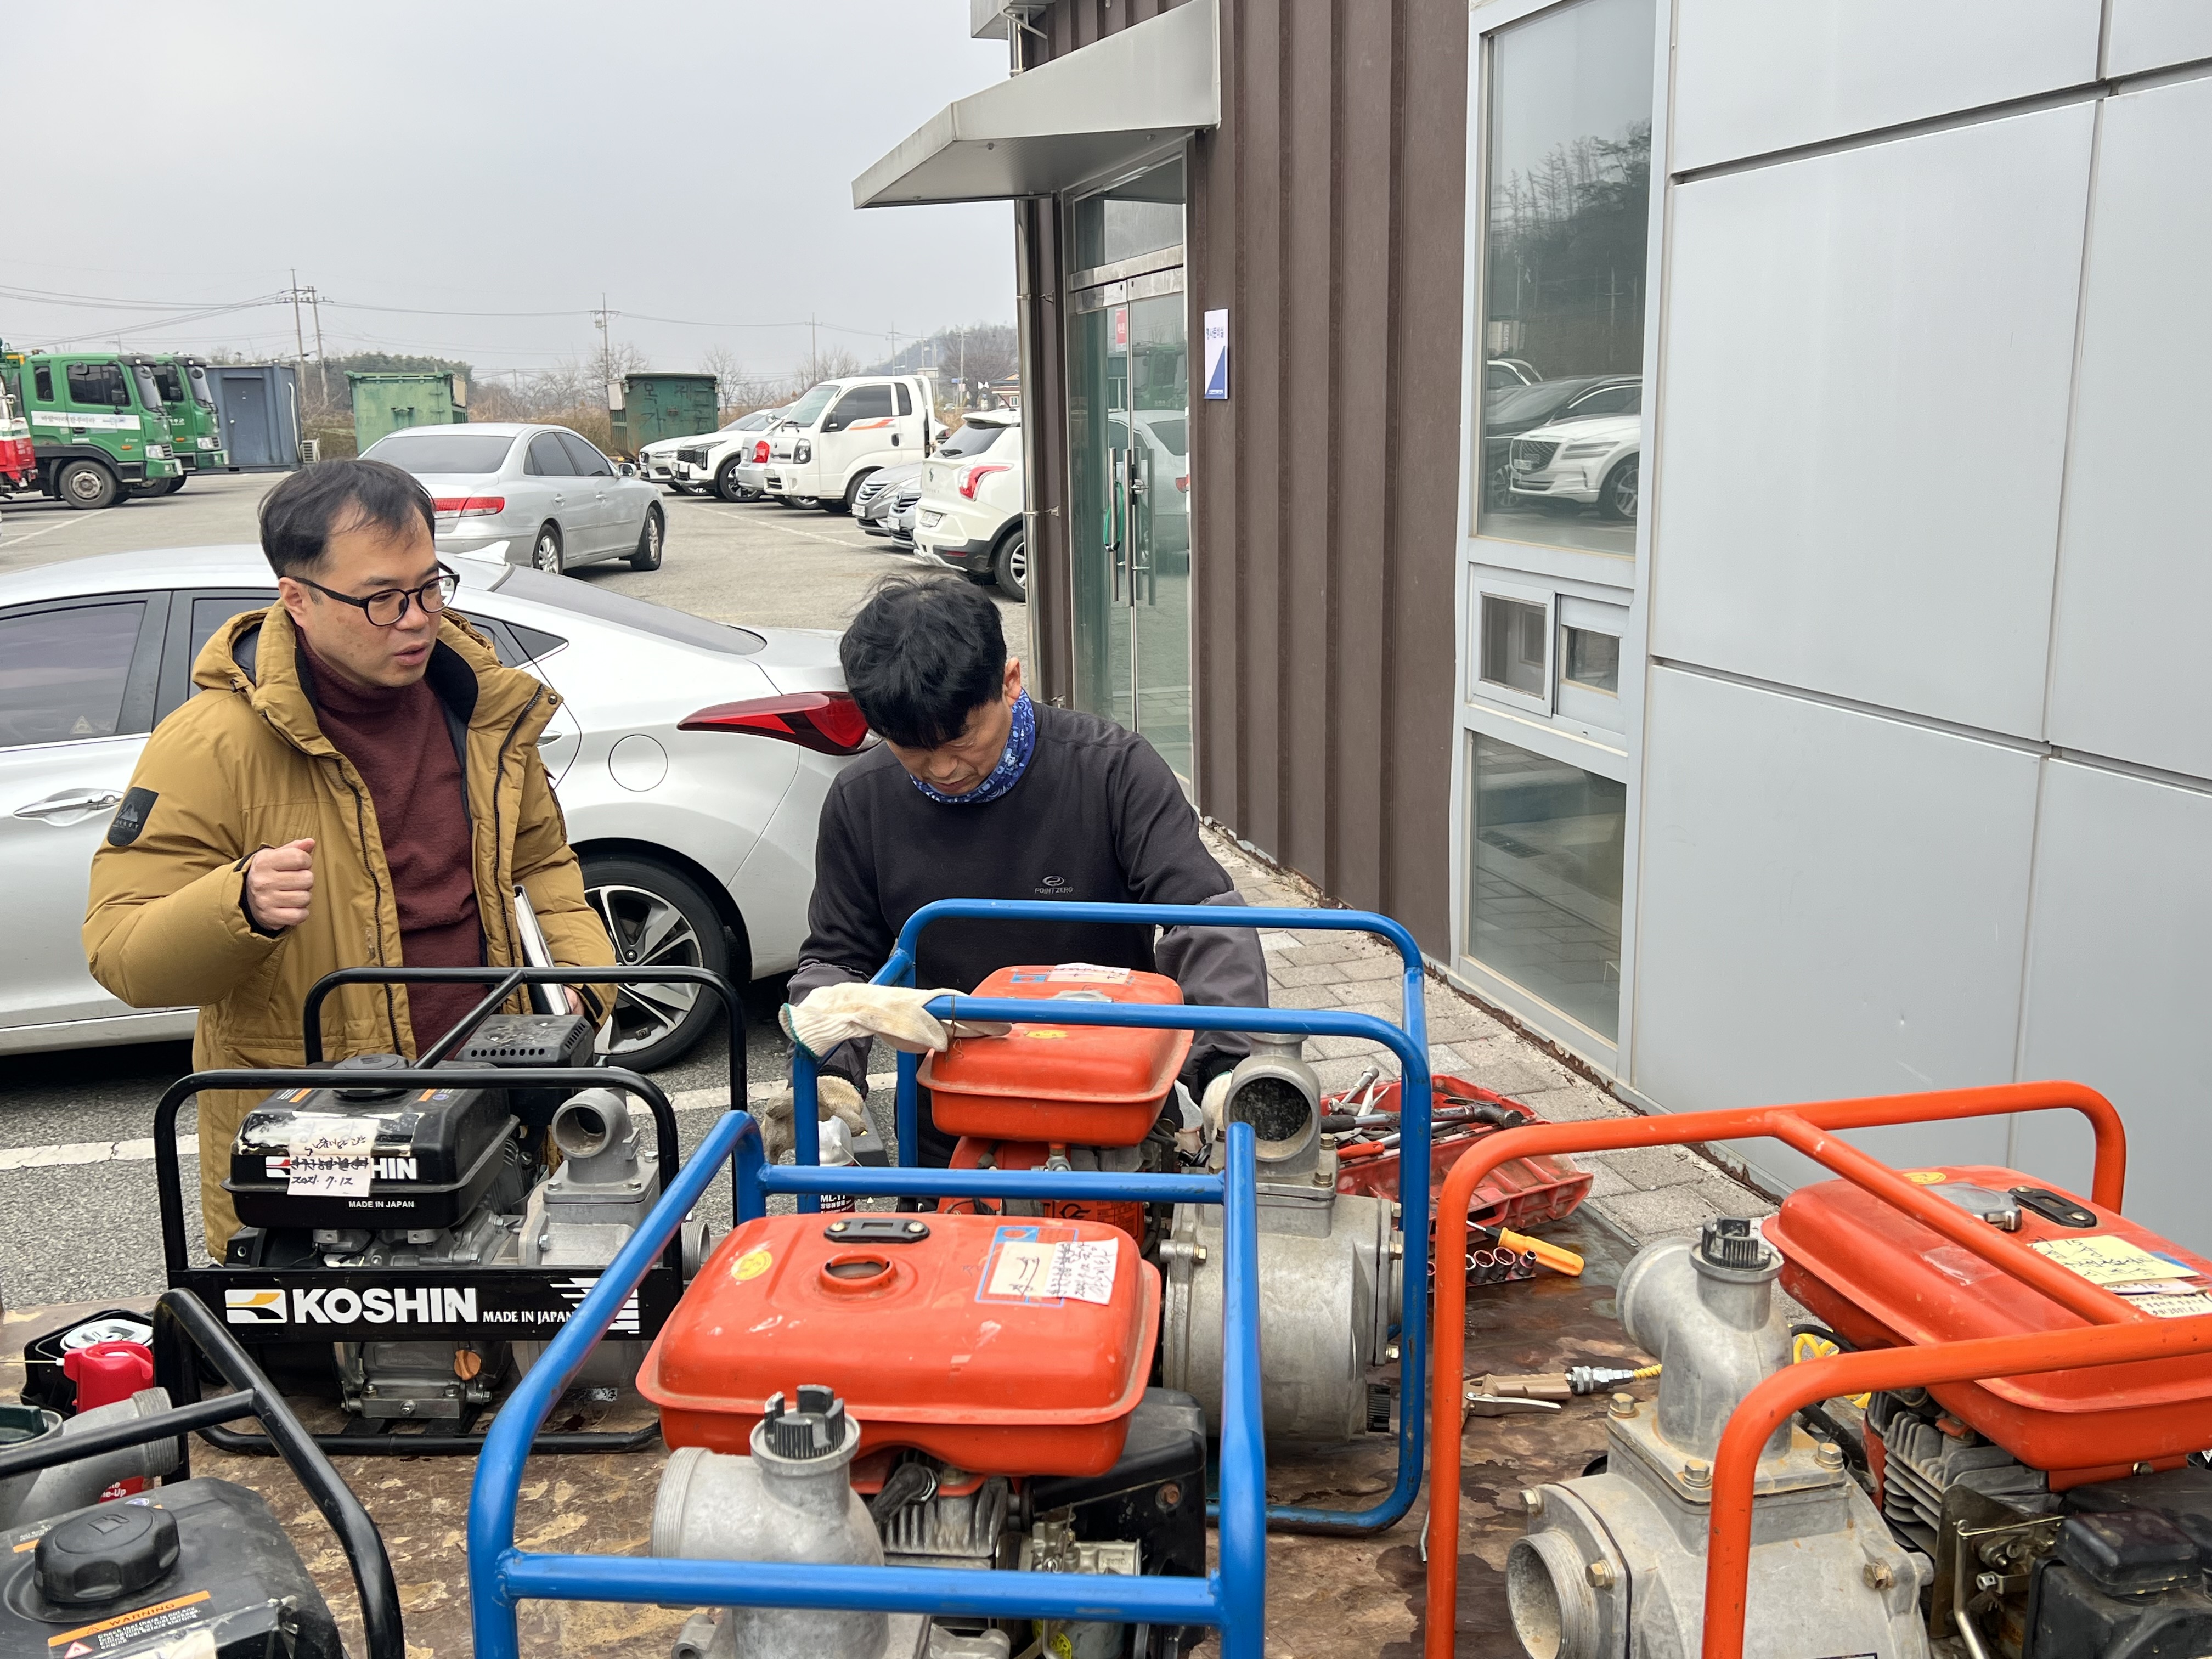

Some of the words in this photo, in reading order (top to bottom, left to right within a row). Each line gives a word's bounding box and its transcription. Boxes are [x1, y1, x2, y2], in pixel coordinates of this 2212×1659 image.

[371, 1158, 417, 1180] HIN
[294, 1288, 477, 1324] KOSHIN
[483, 1310, 518, 1323] MADE
[521, 1310, 534, 1323] IN
[537, 1310, 574, 1325] JAPAN
[110, 1603, 174, 1626] WARNING
